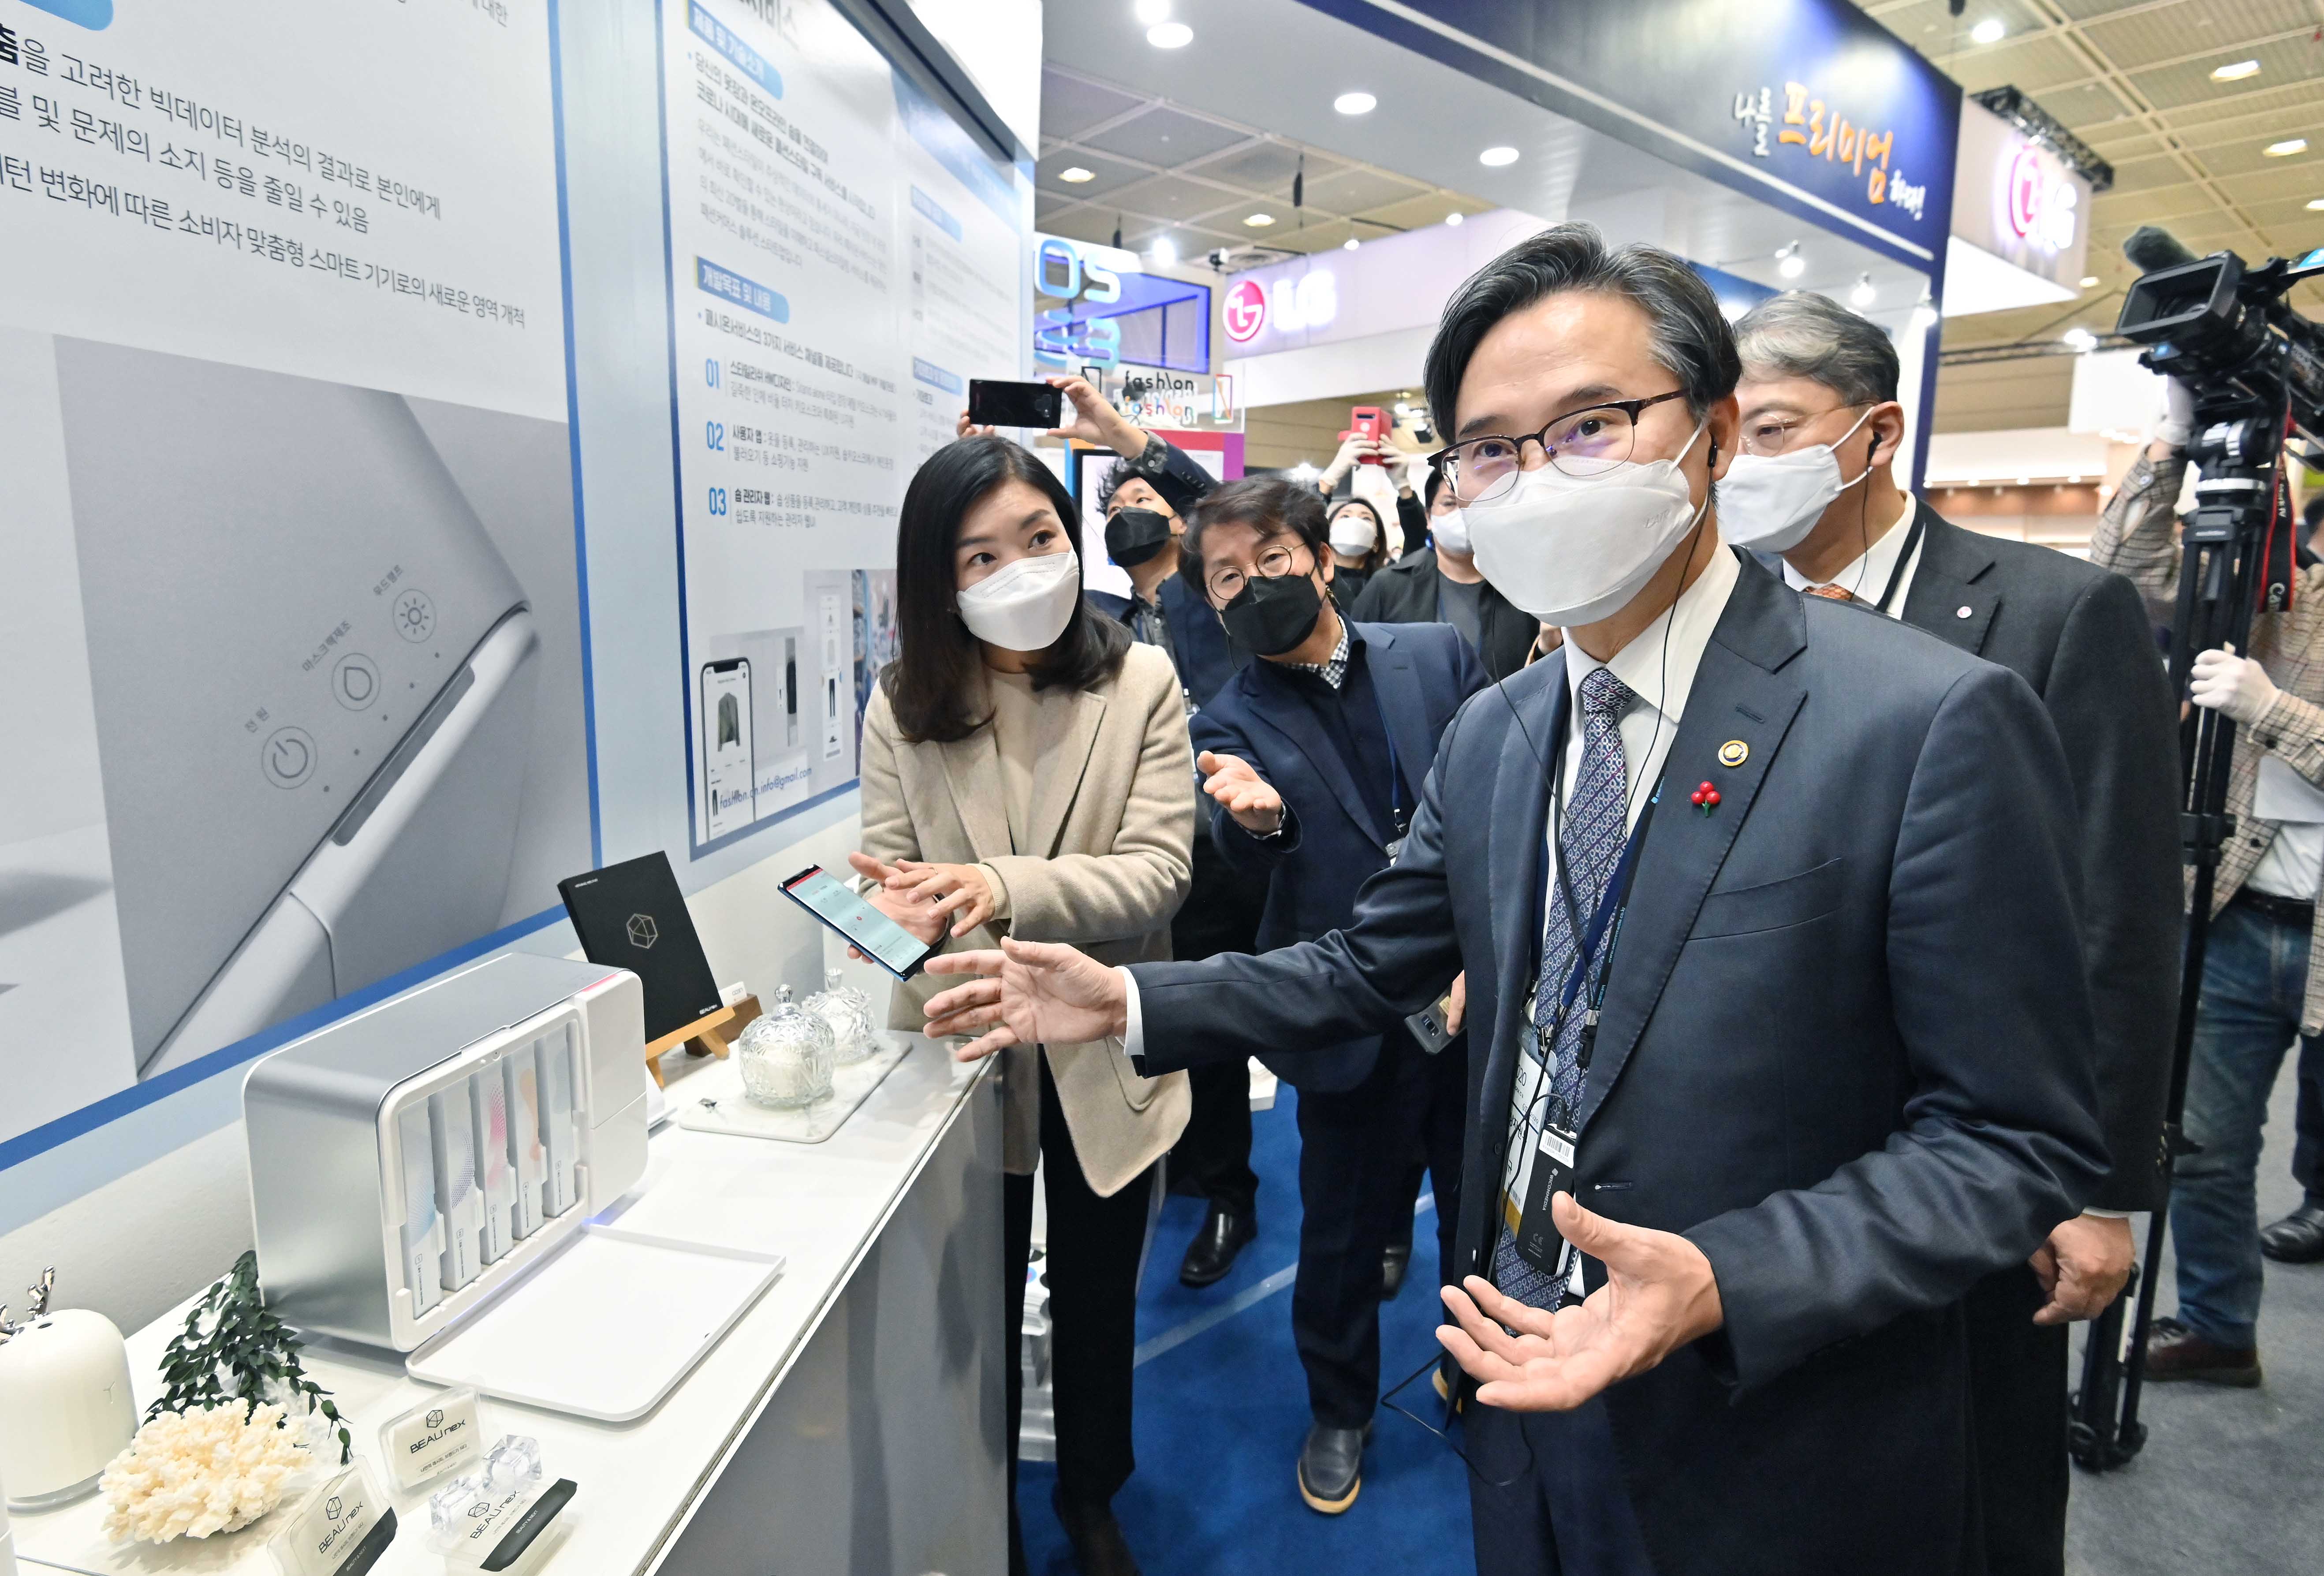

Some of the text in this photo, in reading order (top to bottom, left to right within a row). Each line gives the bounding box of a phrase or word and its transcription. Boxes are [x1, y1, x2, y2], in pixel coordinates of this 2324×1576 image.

[60, 53, 142, 110] 고려한
[149, 86, 243, 148] 빅데이터
[250, 126, 311, 172] 분석의
[317, 151, 372, 192] 결과로
[377, 175, 440, 220] 본인에게
[1779, 81, 1895, 205] 프리미엄
[32, 94, 60, 134] 및
[70, 108, 150, 163] 문제의
[158, 142, 205, 181] 소지
[213, 158, 257, 197] 등을
[263, 175, 303, 213] 줄일
[309, 193, 328, 218] 수
[333, 200, 369, 234] 있음
[0, 152, 524, 326] 턴 변화에 따른 소비자 맞춤형 스마트 기기로의 새로운 영역 개척
[1272, 270, 1337, 331] LG
[706, 358, 720, 390] 01
[706, 421, 724, 451] 02
[733, 424, 753, 442] 사용자
[709, 488, 727, 516] 03
[735, 488, 741, 503] 숍
[743, 489, 763, 504] 관리자
[1542, 1174, 1554, 1211] WICOMMEDIA
[515, 1521, 529, 1534] BEAUTY
